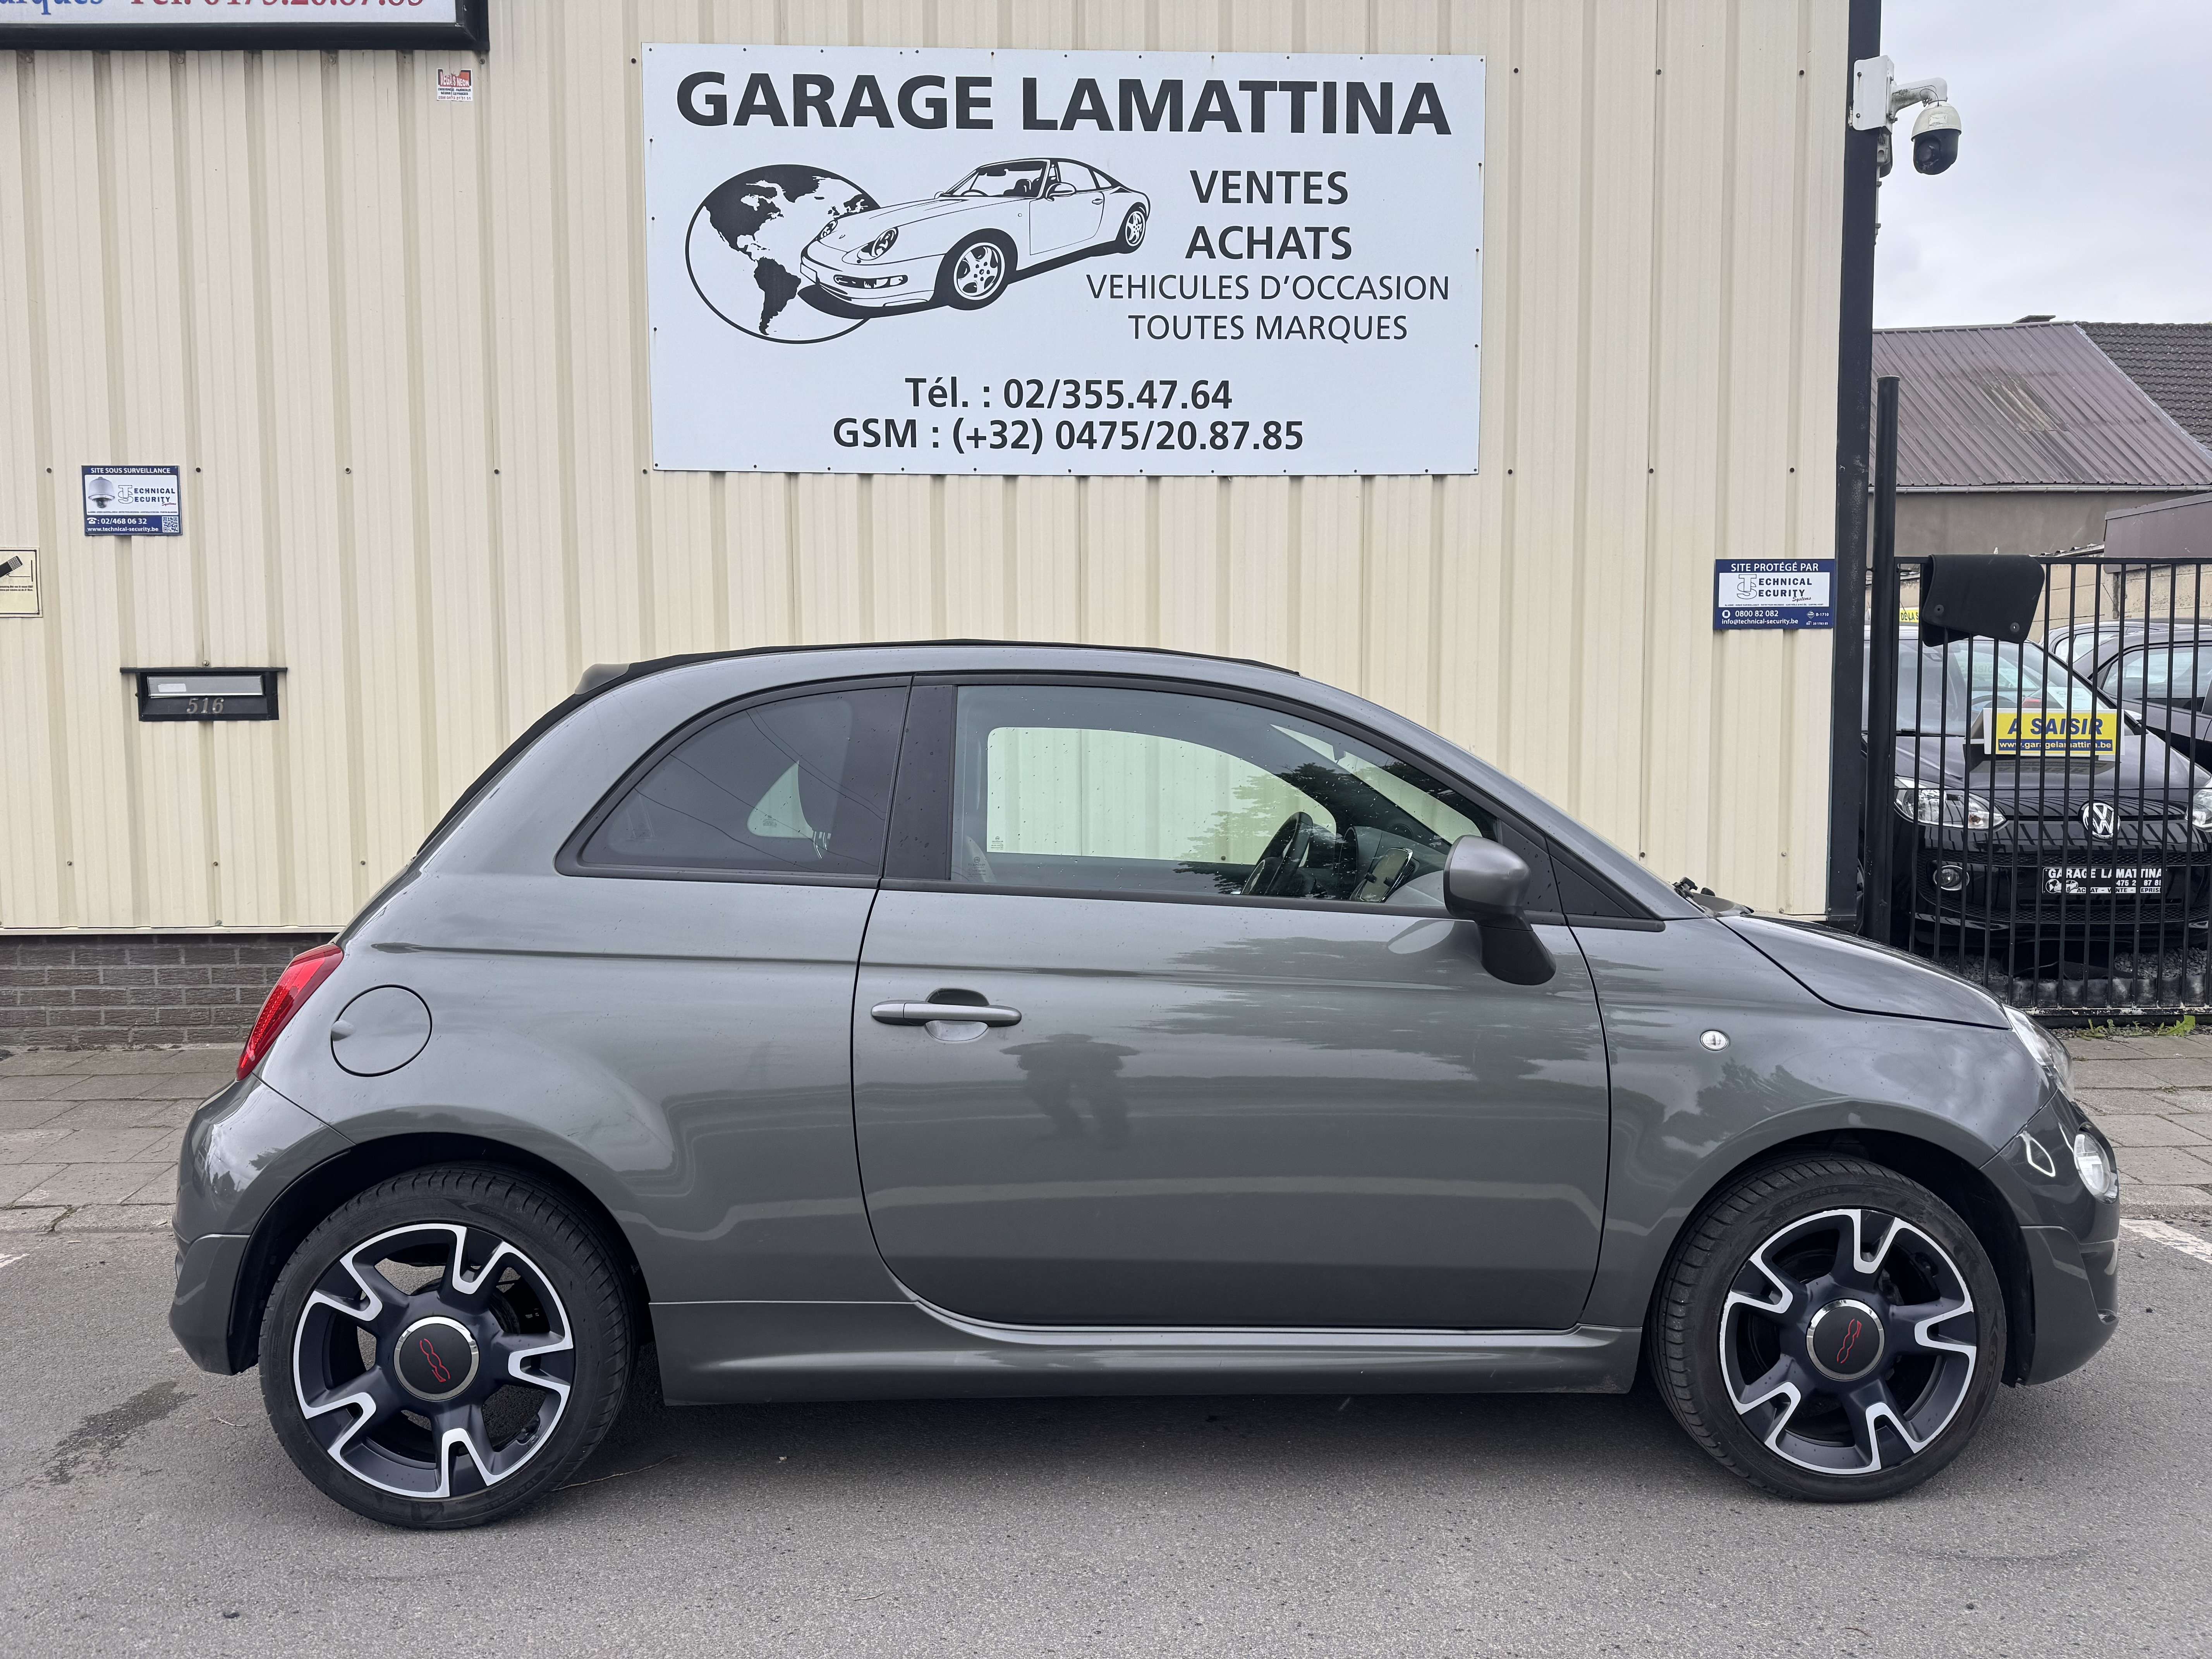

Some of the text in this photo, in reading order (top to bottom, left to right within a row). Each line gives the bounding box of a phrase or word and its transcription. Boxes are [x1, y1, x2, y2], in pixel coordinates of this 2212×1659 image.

[440, 71, 469, 87] VEGAS NEON
[677, 71, 1452, 135] GARAGE LAMATTINA
[1189, 170, 1348, 205] VENTES
[1185, 225, 1352, 260] ACHATS
[1086, 274, 1448, 300] VEHICULES D'OCCASION
[1128, 315, 1407, 344] TOUTES MARQUES
[905, 376, 1232, 409] Tél. : 02/355.47.64
[833, 417, 1303, 455] GSM : (+32) 0475/20.87.85
[118, 485, 176, 498] TECHNICAL
[118, 491, 170, 504] SECURITY
[1731, 562, 1819, 572] SITE PROTÉGÉ PAR
[1736, 582, 1805, 599] SECURITY
[1738, 574, 1812, 592] TECHNICAL
[187, 697, 224, 714] 516
[2007, 718, 2103, 735] A SAISIR
[2048, 868, 2096, 879] GARAGE
